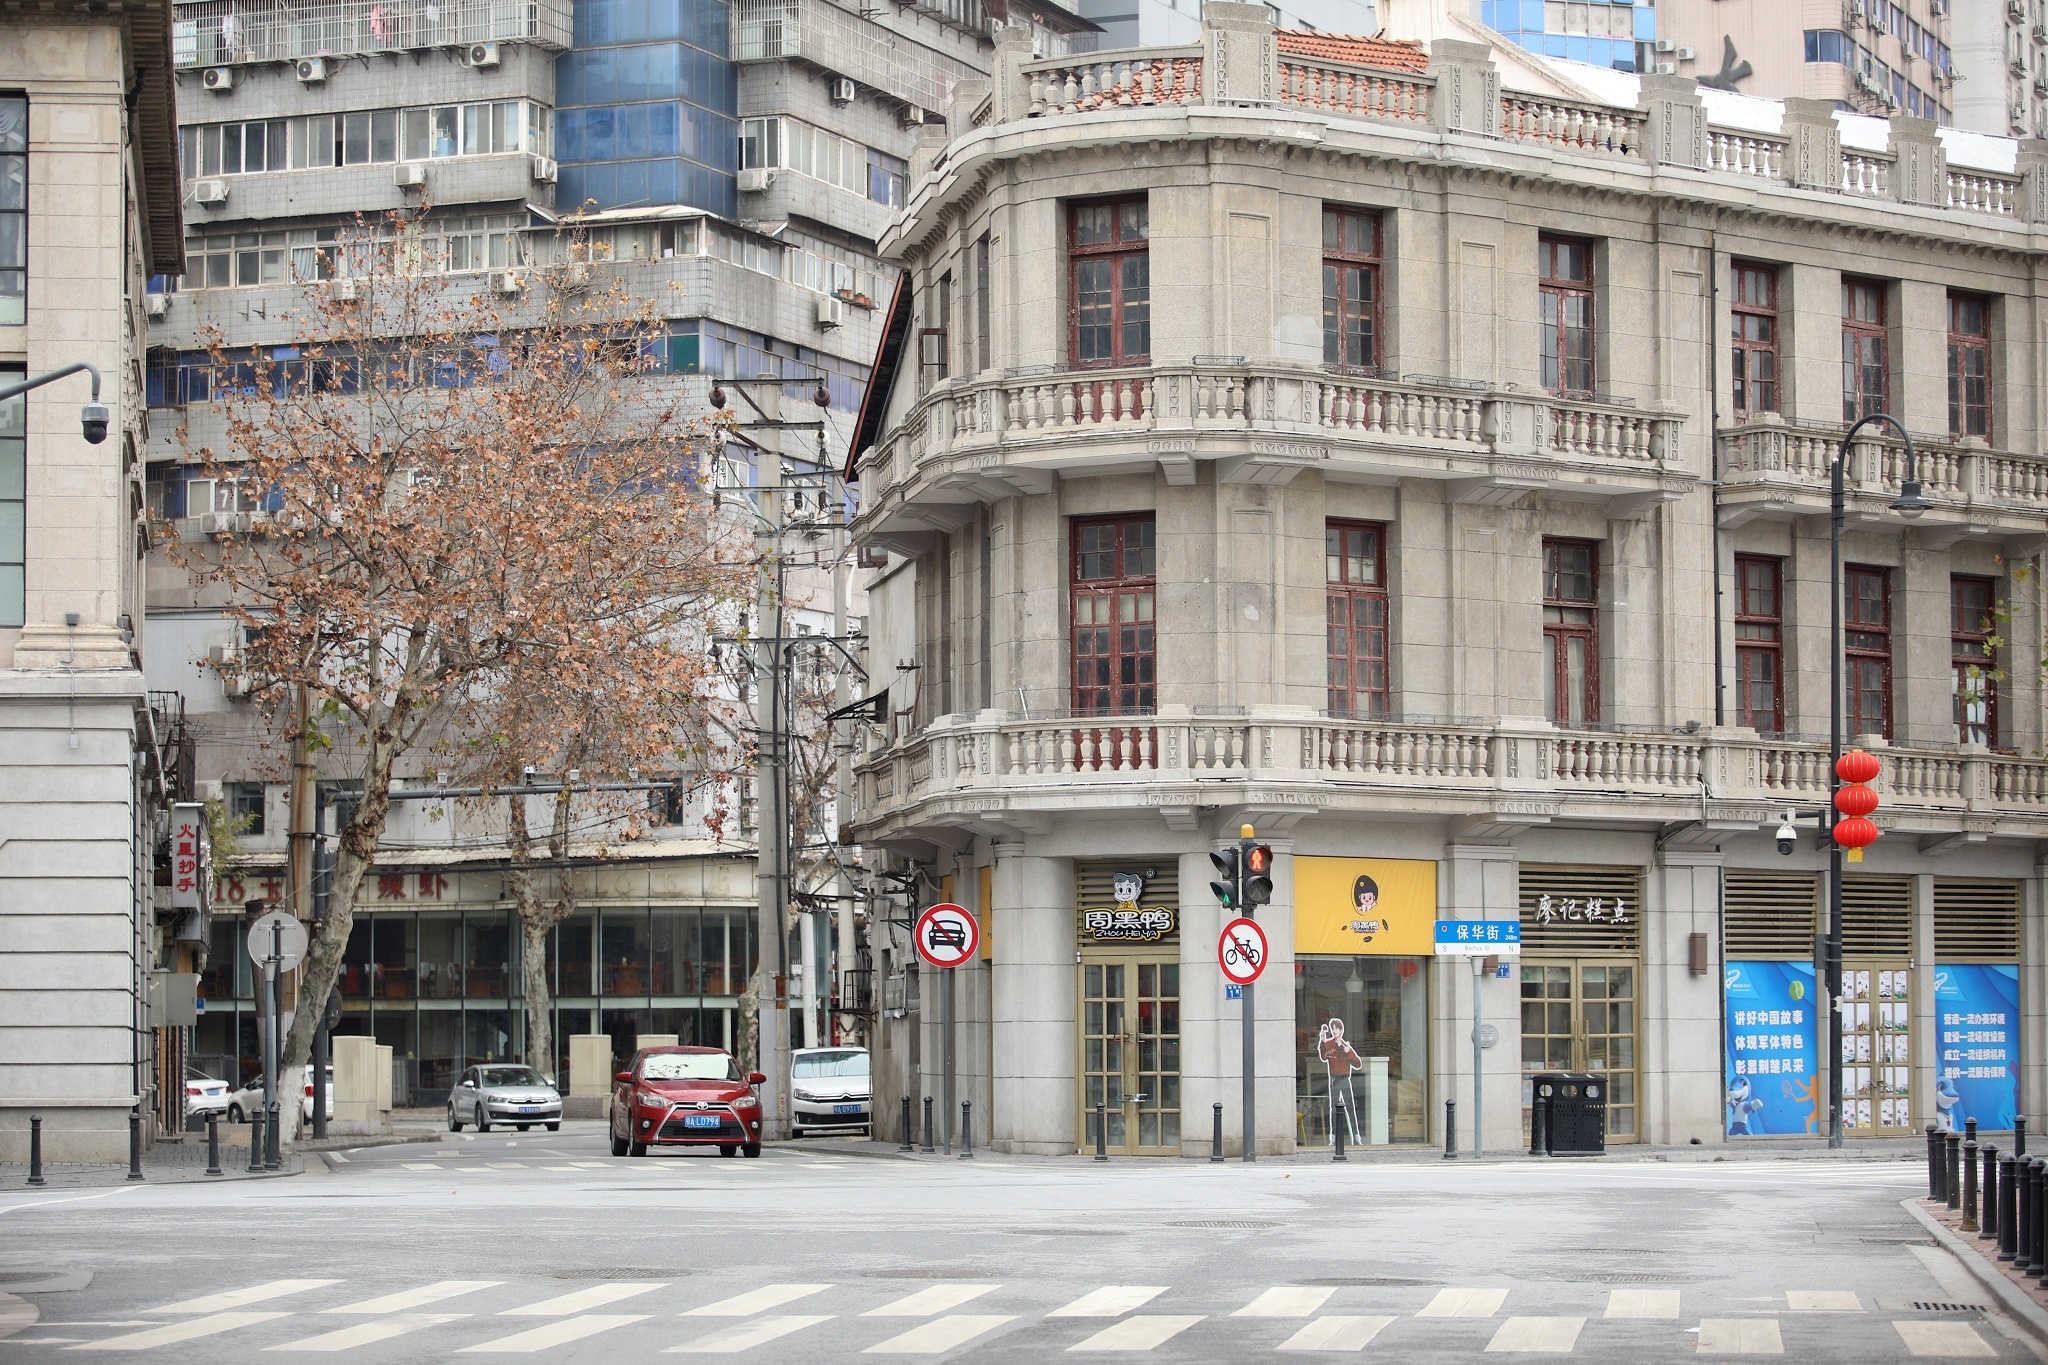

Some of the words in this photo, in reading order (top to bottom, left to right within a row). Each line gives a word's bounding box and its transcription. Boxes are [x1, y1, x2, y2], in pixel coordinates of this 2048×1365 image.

[176, 823, 196, 893] 火星抄手
[1536, 894, 1629, 926] 廖记糕点
[1085, 910, 1171, 931] 周黑鸭
[1350, 920, 1380, 930] 周黑鸭
[1456, 924, 1500, 941] 保华街
[1507, 925, 1515, 933] 北
[1442, 945, 1448, 953] S
[1735, 1010, 1803, 1025] 讲好中国故事
[1943, 1013, 2006, 1025] 营造一流办赛环境
[1735, 1035, 1803, 1050] 体现军体特色
[1943, 1031, 2006, 1043] 建设一流场馆设施
[1944, 1049, 2006, 1061] 成立一流组织机构
[1735, 1059, 1804, 1074] 彰显荆楚风采
[1944, 1066, 2006, 1079] 提供一流服务保障
